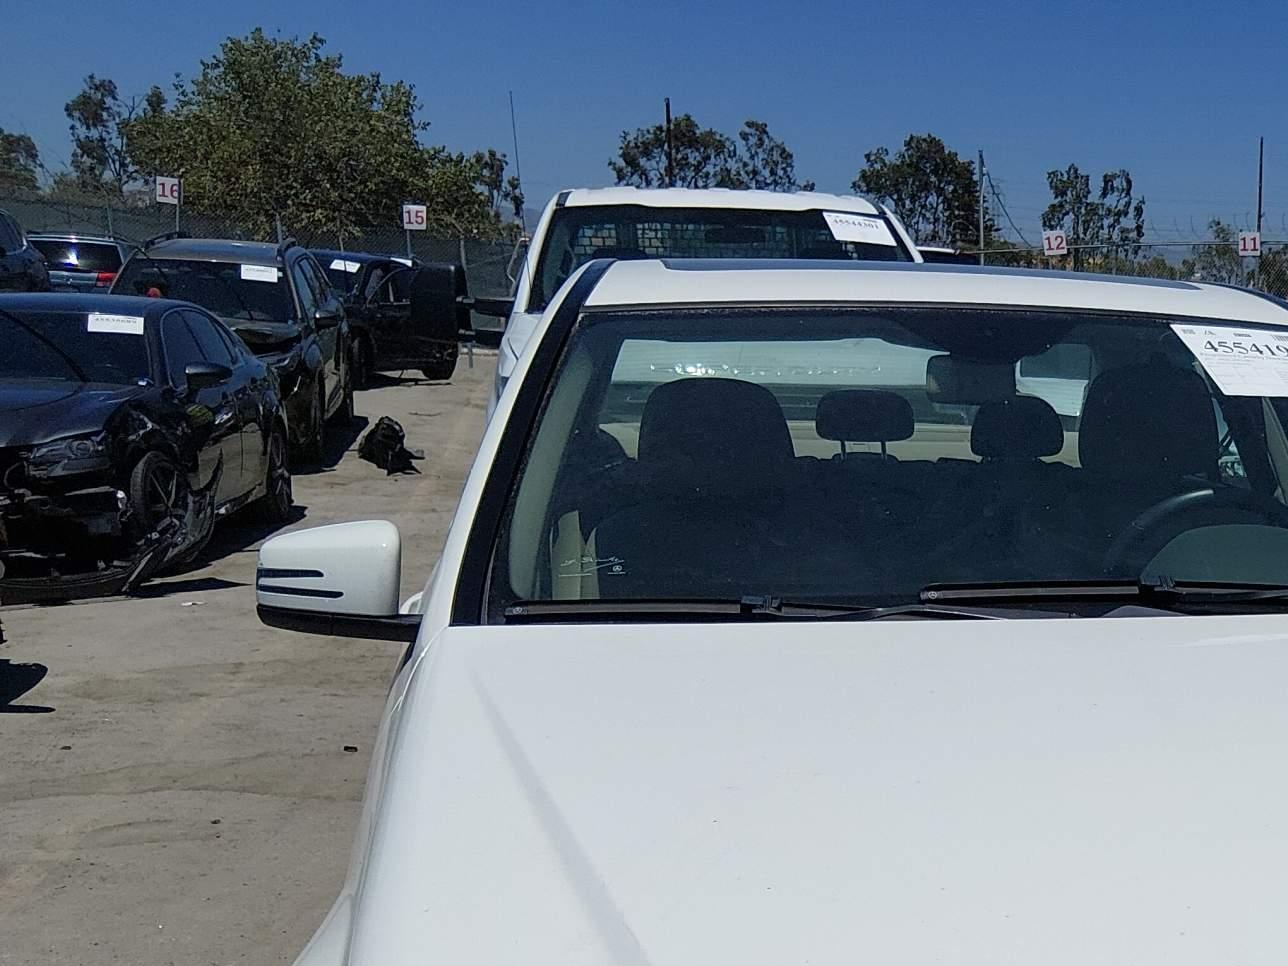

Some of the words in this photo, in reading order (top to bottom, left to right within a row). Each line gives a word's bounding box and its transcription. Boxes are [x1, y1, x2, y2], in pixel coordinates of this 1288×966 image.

[158, 182, 178, 199] 16
[405, 210, 425, 225] 15
[1044, 235, 1066, 251] 12
[1240, 236, 1259, 252] 11
